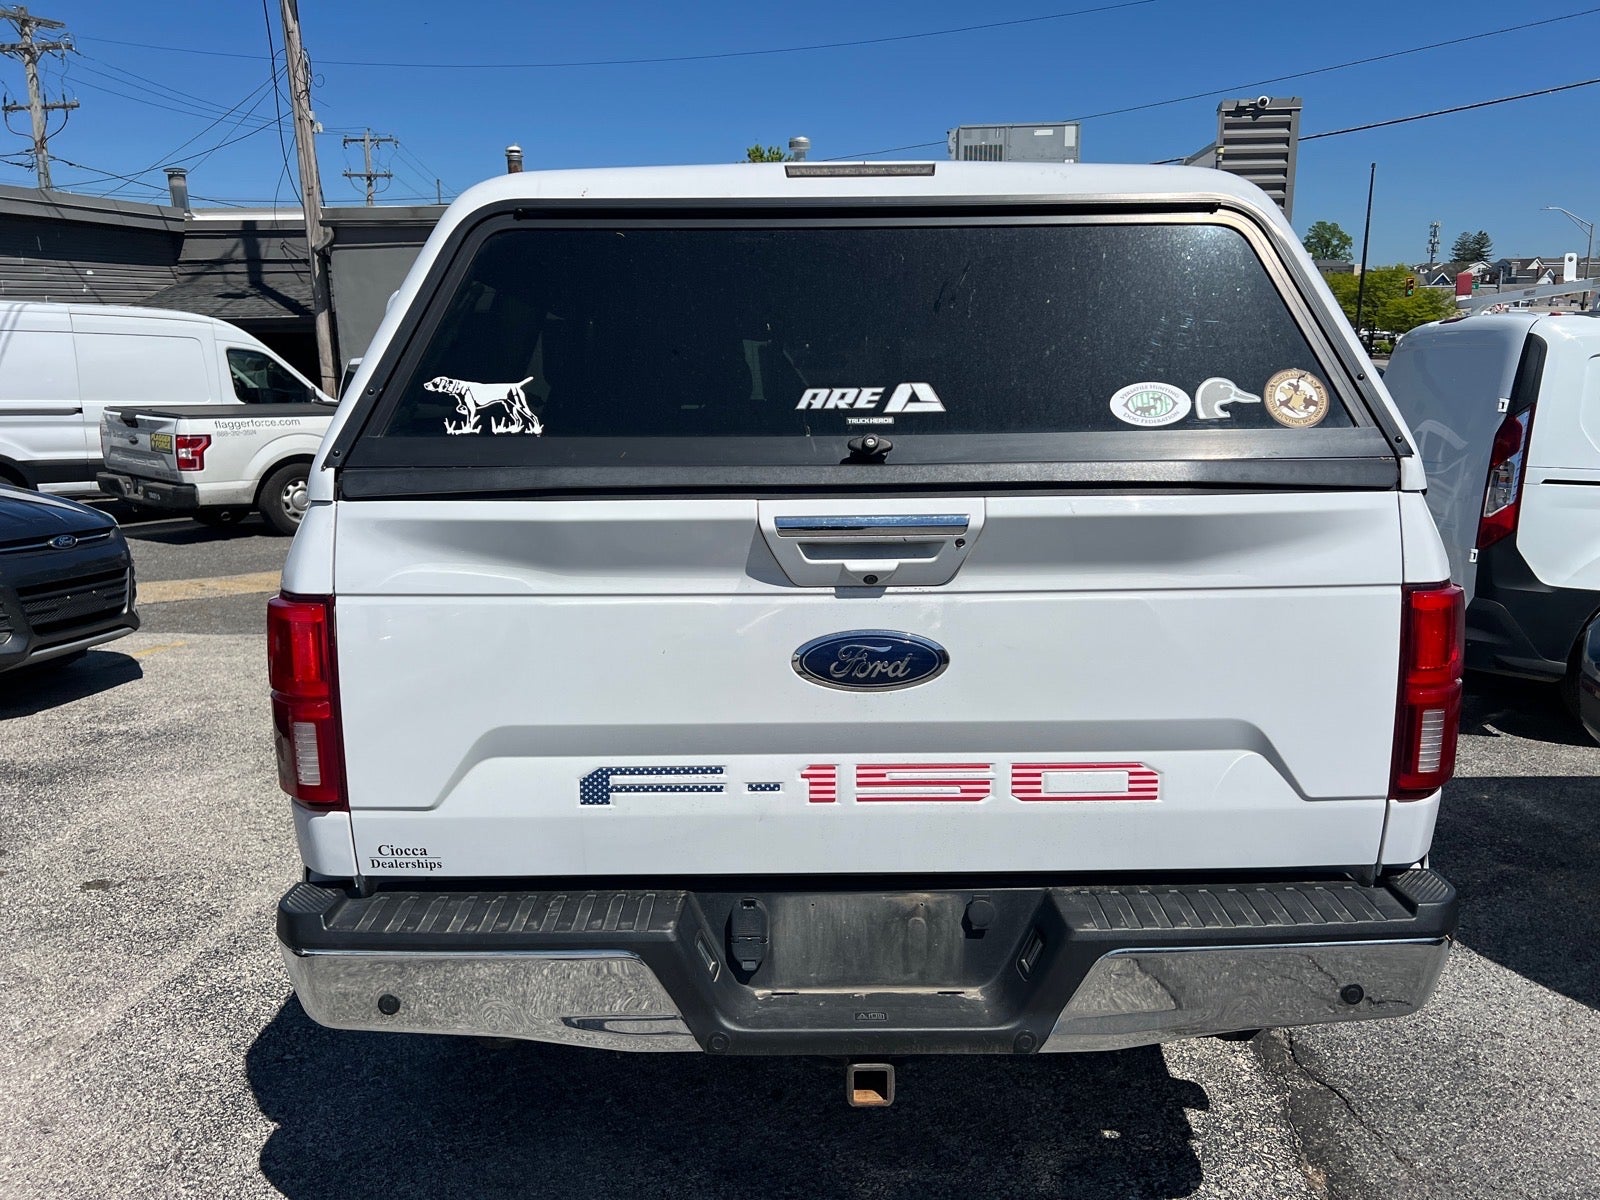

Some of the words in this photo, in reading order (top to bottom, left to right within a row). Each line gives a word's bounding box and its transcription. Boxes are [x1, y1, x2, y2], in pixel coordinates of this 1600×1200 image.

[795, 387, 886, 409] ARE
[214, 419, 301, 430] flaggerforce.com
[829, 644, 913, 678] Ford
[579, 763, 1160, 805] F-150
[377, 844, 428, 856] Ciocca
[370, 858, 442, 871] Dealerships
